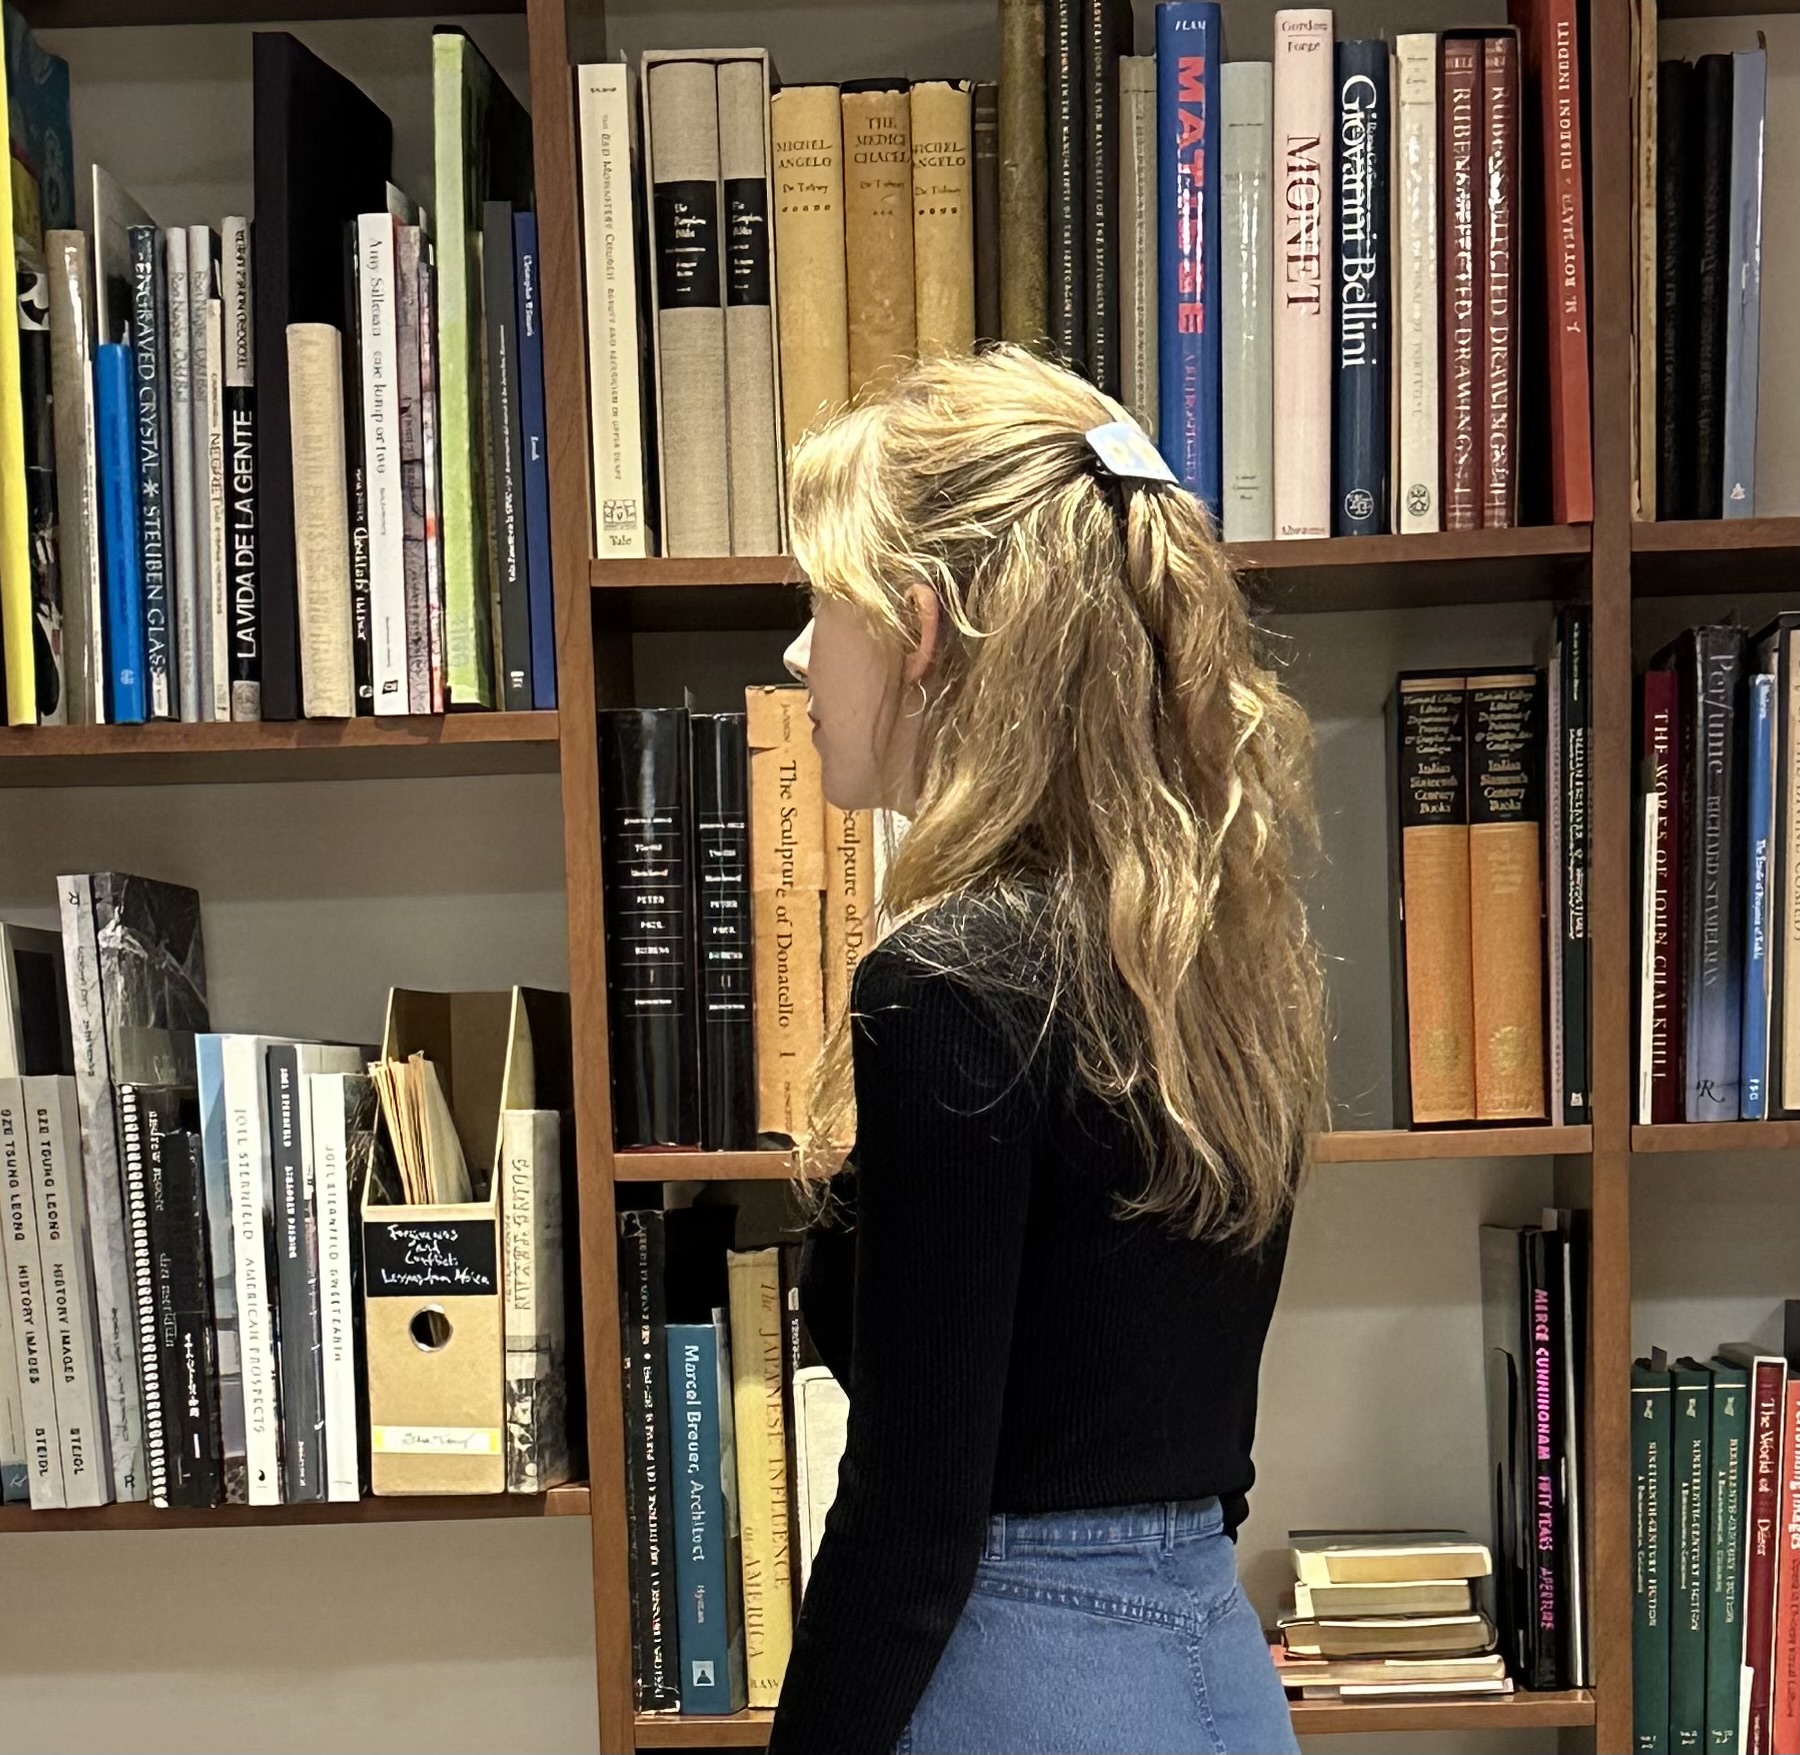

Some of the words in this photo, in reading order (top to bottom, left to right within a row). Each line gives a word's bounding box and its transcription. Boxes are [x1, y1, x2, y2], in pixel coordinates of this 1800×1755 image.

[1341, 75, 1377, 242] Giovanni
[1453, 88, 1472, 177] RUBENS
[1178, 57, 1206, 334] MATISSE
[1286, 135, 1321, 316] MONET
[1341, 257, 1377, 368] Bellini
[140, 385, 158, 473] CRYSTAL
[1453, 328, 1473, 466] DRAWINGS
[232, 409, 254, 494] GENTE
[234, 497, 254, 530] LA
[144, 505, 163, 600] STEUBEN
[234, 533, 255, 567] DE
[235, 571, 256, 627] VIDA
[236, 627, 256, 659] LA
[1655, 708, 1669, 753] THE
[1704, 655, 1735, 775] Perfume
[780, 760, 797, 800] The
[775, 806, 798, 899] Sculpture
[776, 905, 794, 928] of
[845, 904, 861, 926] of
[1655, 889, 1668, 945] JOHN
[776, 933, 794, 1027] Donatello
[11, 1194, 25, 1241] LEONG
[45, 1193, 60, 1241] LEONG
[761, 1283, 777, 1313] The
[1534, 1288, 1549, 1342] MERCE
[685, 1344, 702, 1405] Marcel
[759, 1328, 784, 1443] JAPANESE
[1759, 1398, 1775, 1428] The
[1758, 1431, 1776, 1474] World
[690, 1480, 707, 1561] Architect
[768, 1458, 791, 1591] INFLUENCE
[746, 1560, 767, 1660] AMERICA
